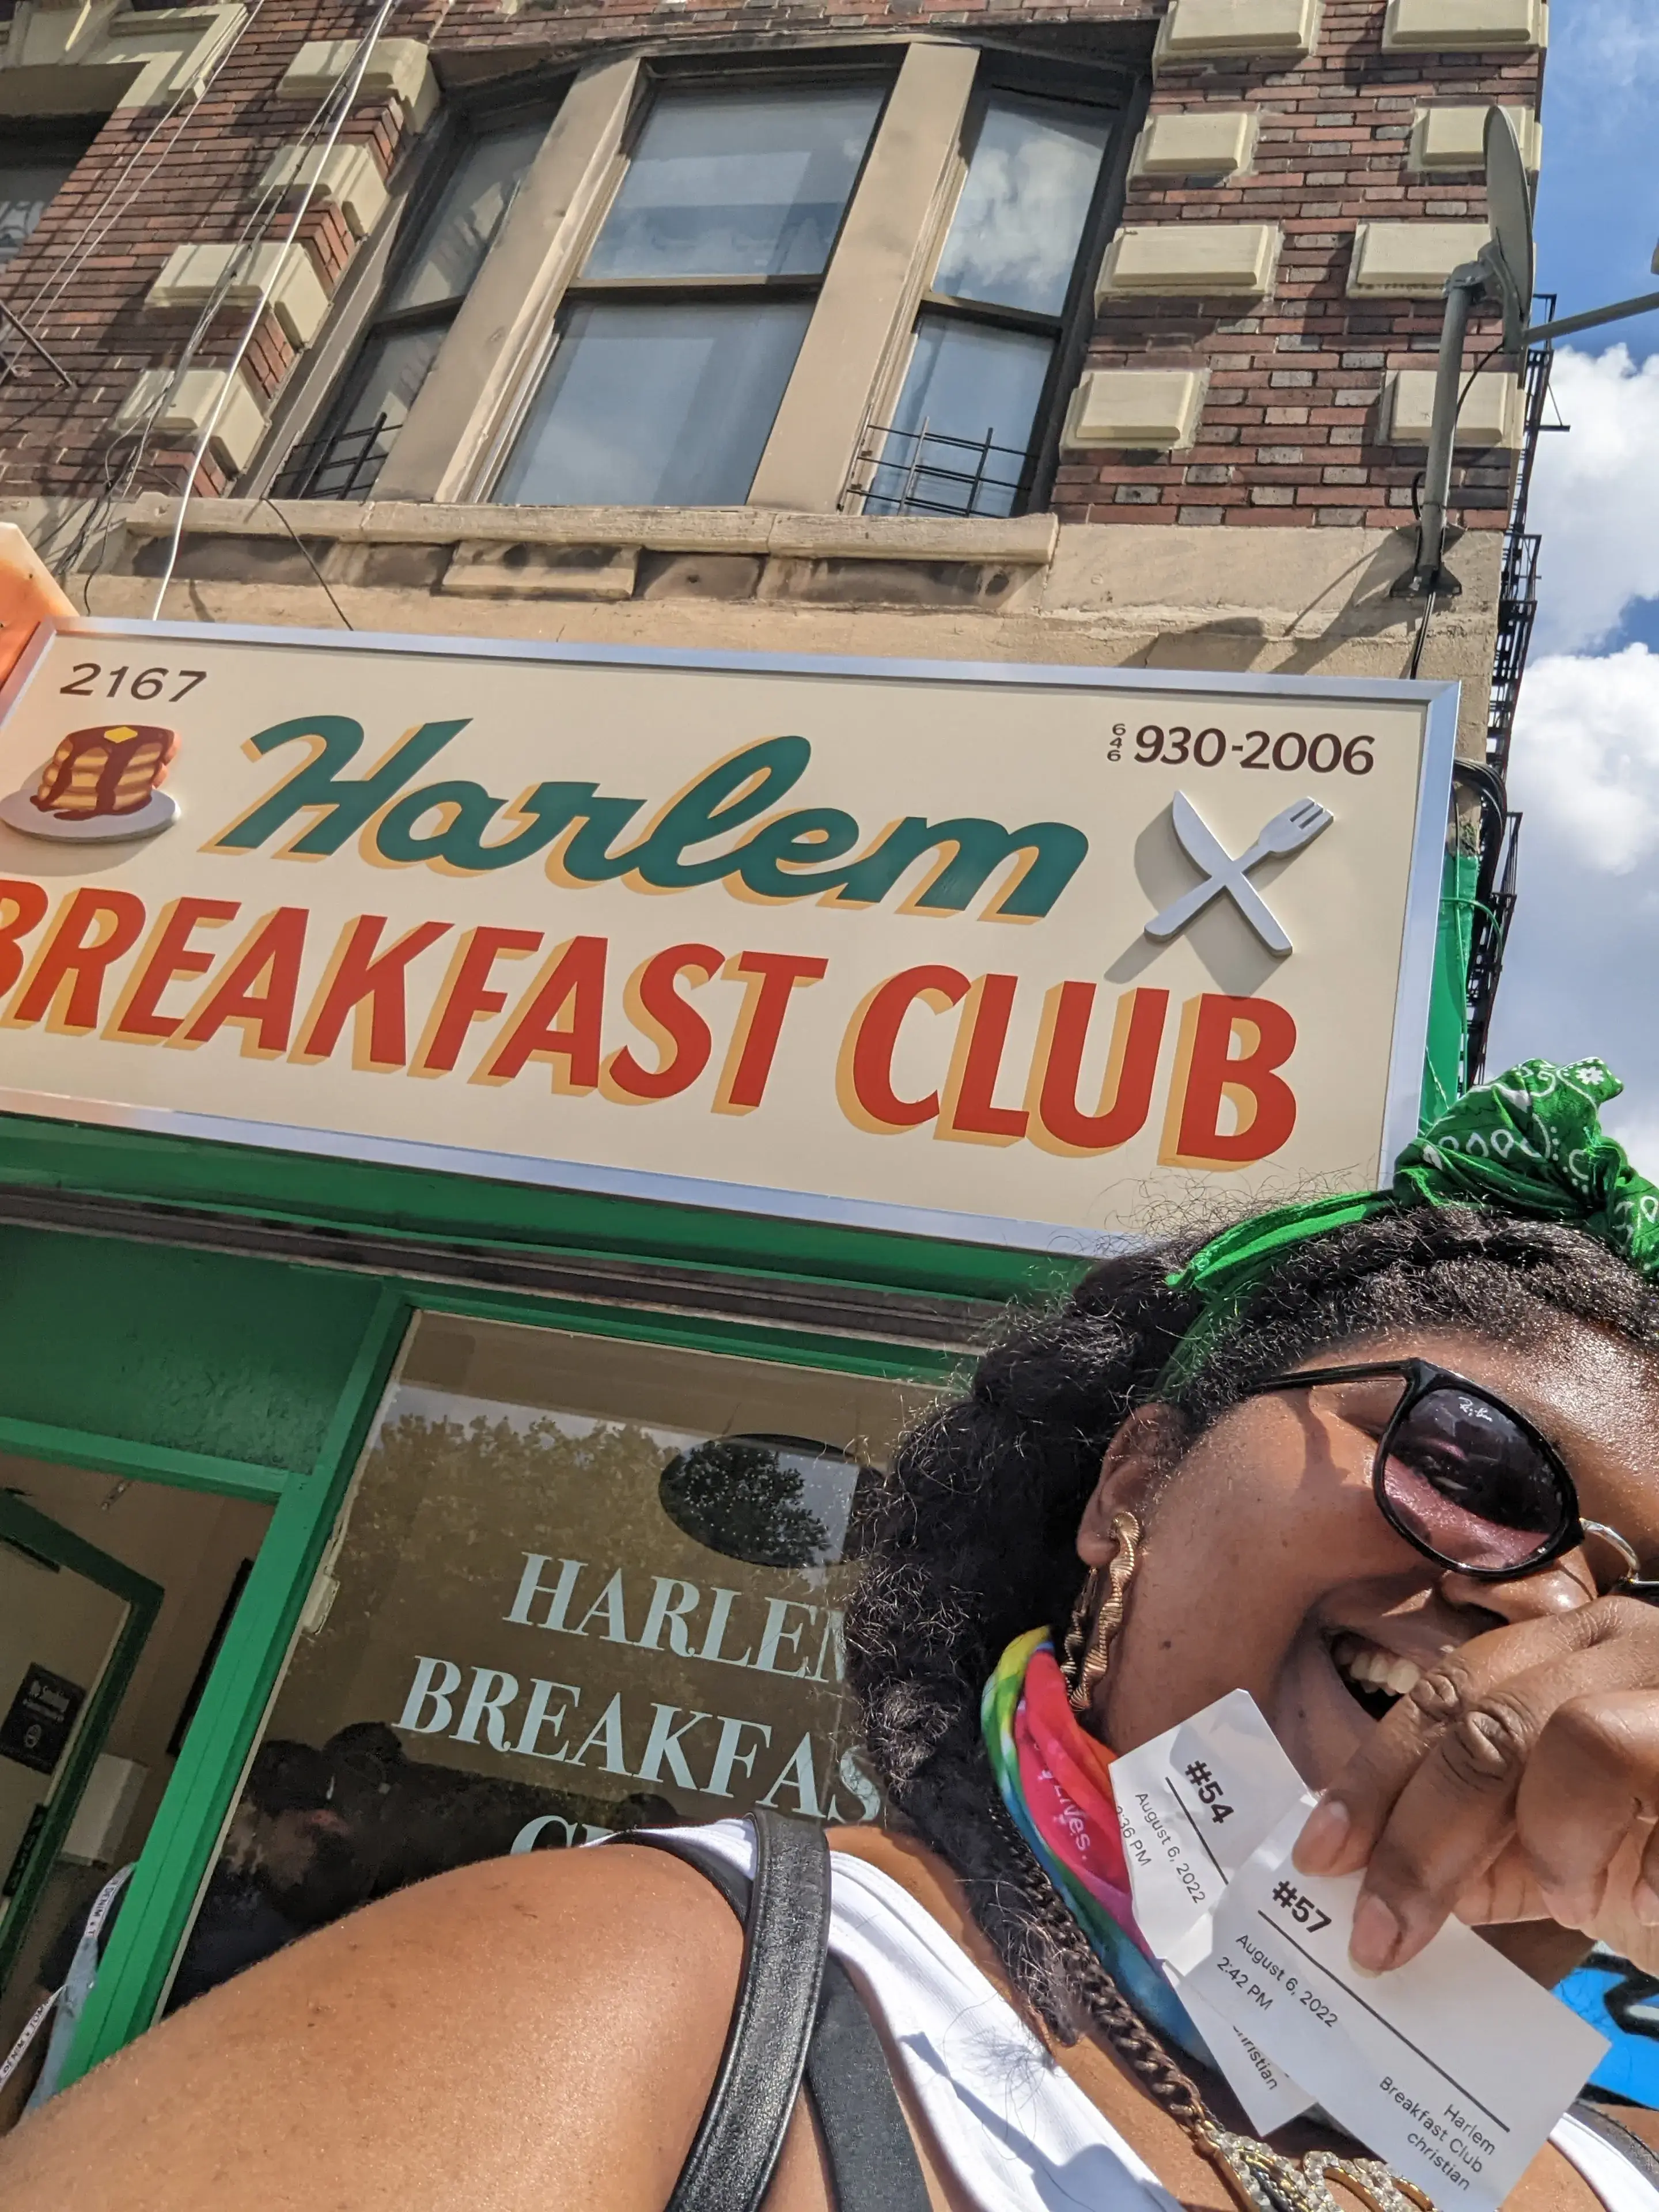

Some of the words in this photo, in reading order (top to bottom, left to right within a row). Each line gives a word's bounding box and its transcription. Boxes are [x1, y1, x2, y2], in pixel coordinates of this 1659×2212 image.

[60, 664, 207, 703] 2167
[1134, 725, 1375, 775] 930-2006
[199, 715, 1089, 925] Harlem
[835, 964, 1297, 1172] CLUB
[1185, 1760, 1234, 1824] #54
[1130, 1840, 1152, 1866] PM
[1135, 1794, 1171, 1845] August
[1168, 1846, 1180, 1862] 6,
[1176, 1863, 1205, 1903] 2022
[1272, 1881, 1332, 1933] #57
[1217, 1956, 1248, 1988] 2:42
[1247, 1984, 1273, 2011] PM
[1236, 1934, 1285, 1981] August
[1286, 1978, 1298, 1995] 6,
[1300, 1991, 1338, 2027] 2022
[1233, 2025, 1278, 2090] ristian
[1380, 2076, 1448, 2142] Breakfast
[1449, 2138, 1483, 2173] Club
[1443, 2104, 1495, 2156] Harlem
[1407, 2133, 1470, 2191] christian
